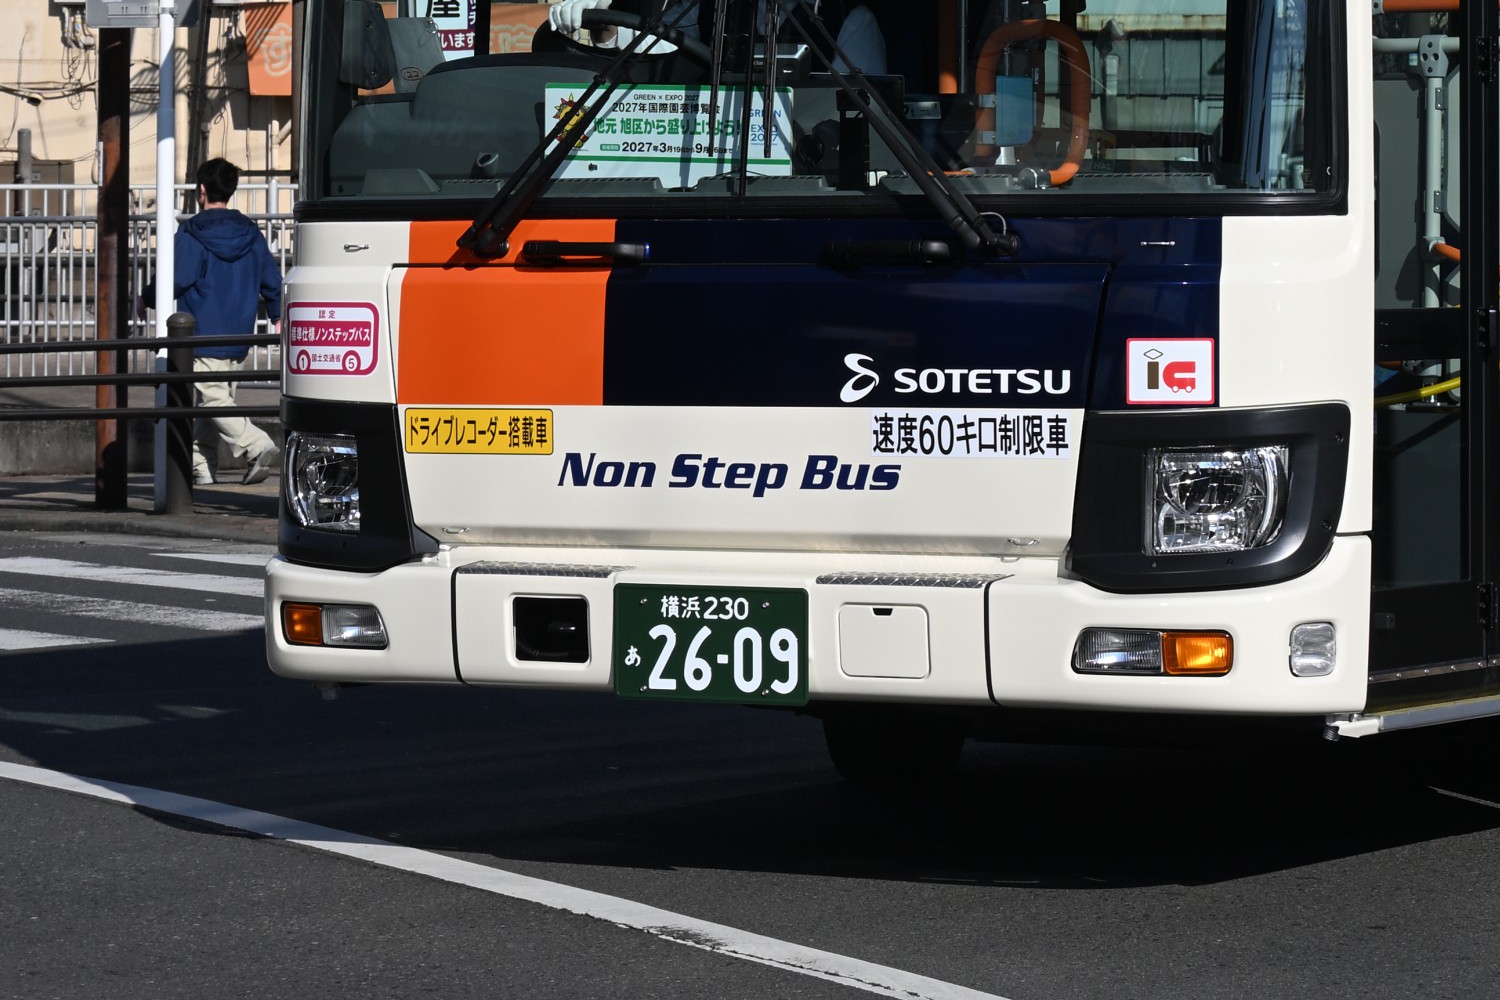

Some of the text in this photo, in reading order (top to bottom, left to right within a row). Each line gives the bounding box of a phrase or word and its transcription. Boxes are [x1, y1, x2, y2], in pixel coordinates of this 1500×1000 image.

[438, 30, 476, 48] います
[750, 109, 781, 118] GRN
[593, 118, 617, 135] 地元
[751, 124, 778, 133] EXO
[751, 133, 779, 141] 207
[318, 309, 336, 319] 認定
[291, 326, 371, 342] 標準仕様ノンステップバス
[311, 353, 342, 362] 国土交通省
[893, 367, 1071, 395] SOTETSU
[409, 415, 548, 449] ドライブレコーダー搭載車
[872, 412, 1070, 456] 速度60キロ制限車
[558, 452, 902, 498] Non Step Bus
[624, 624, 799, 695] あ 26-09
